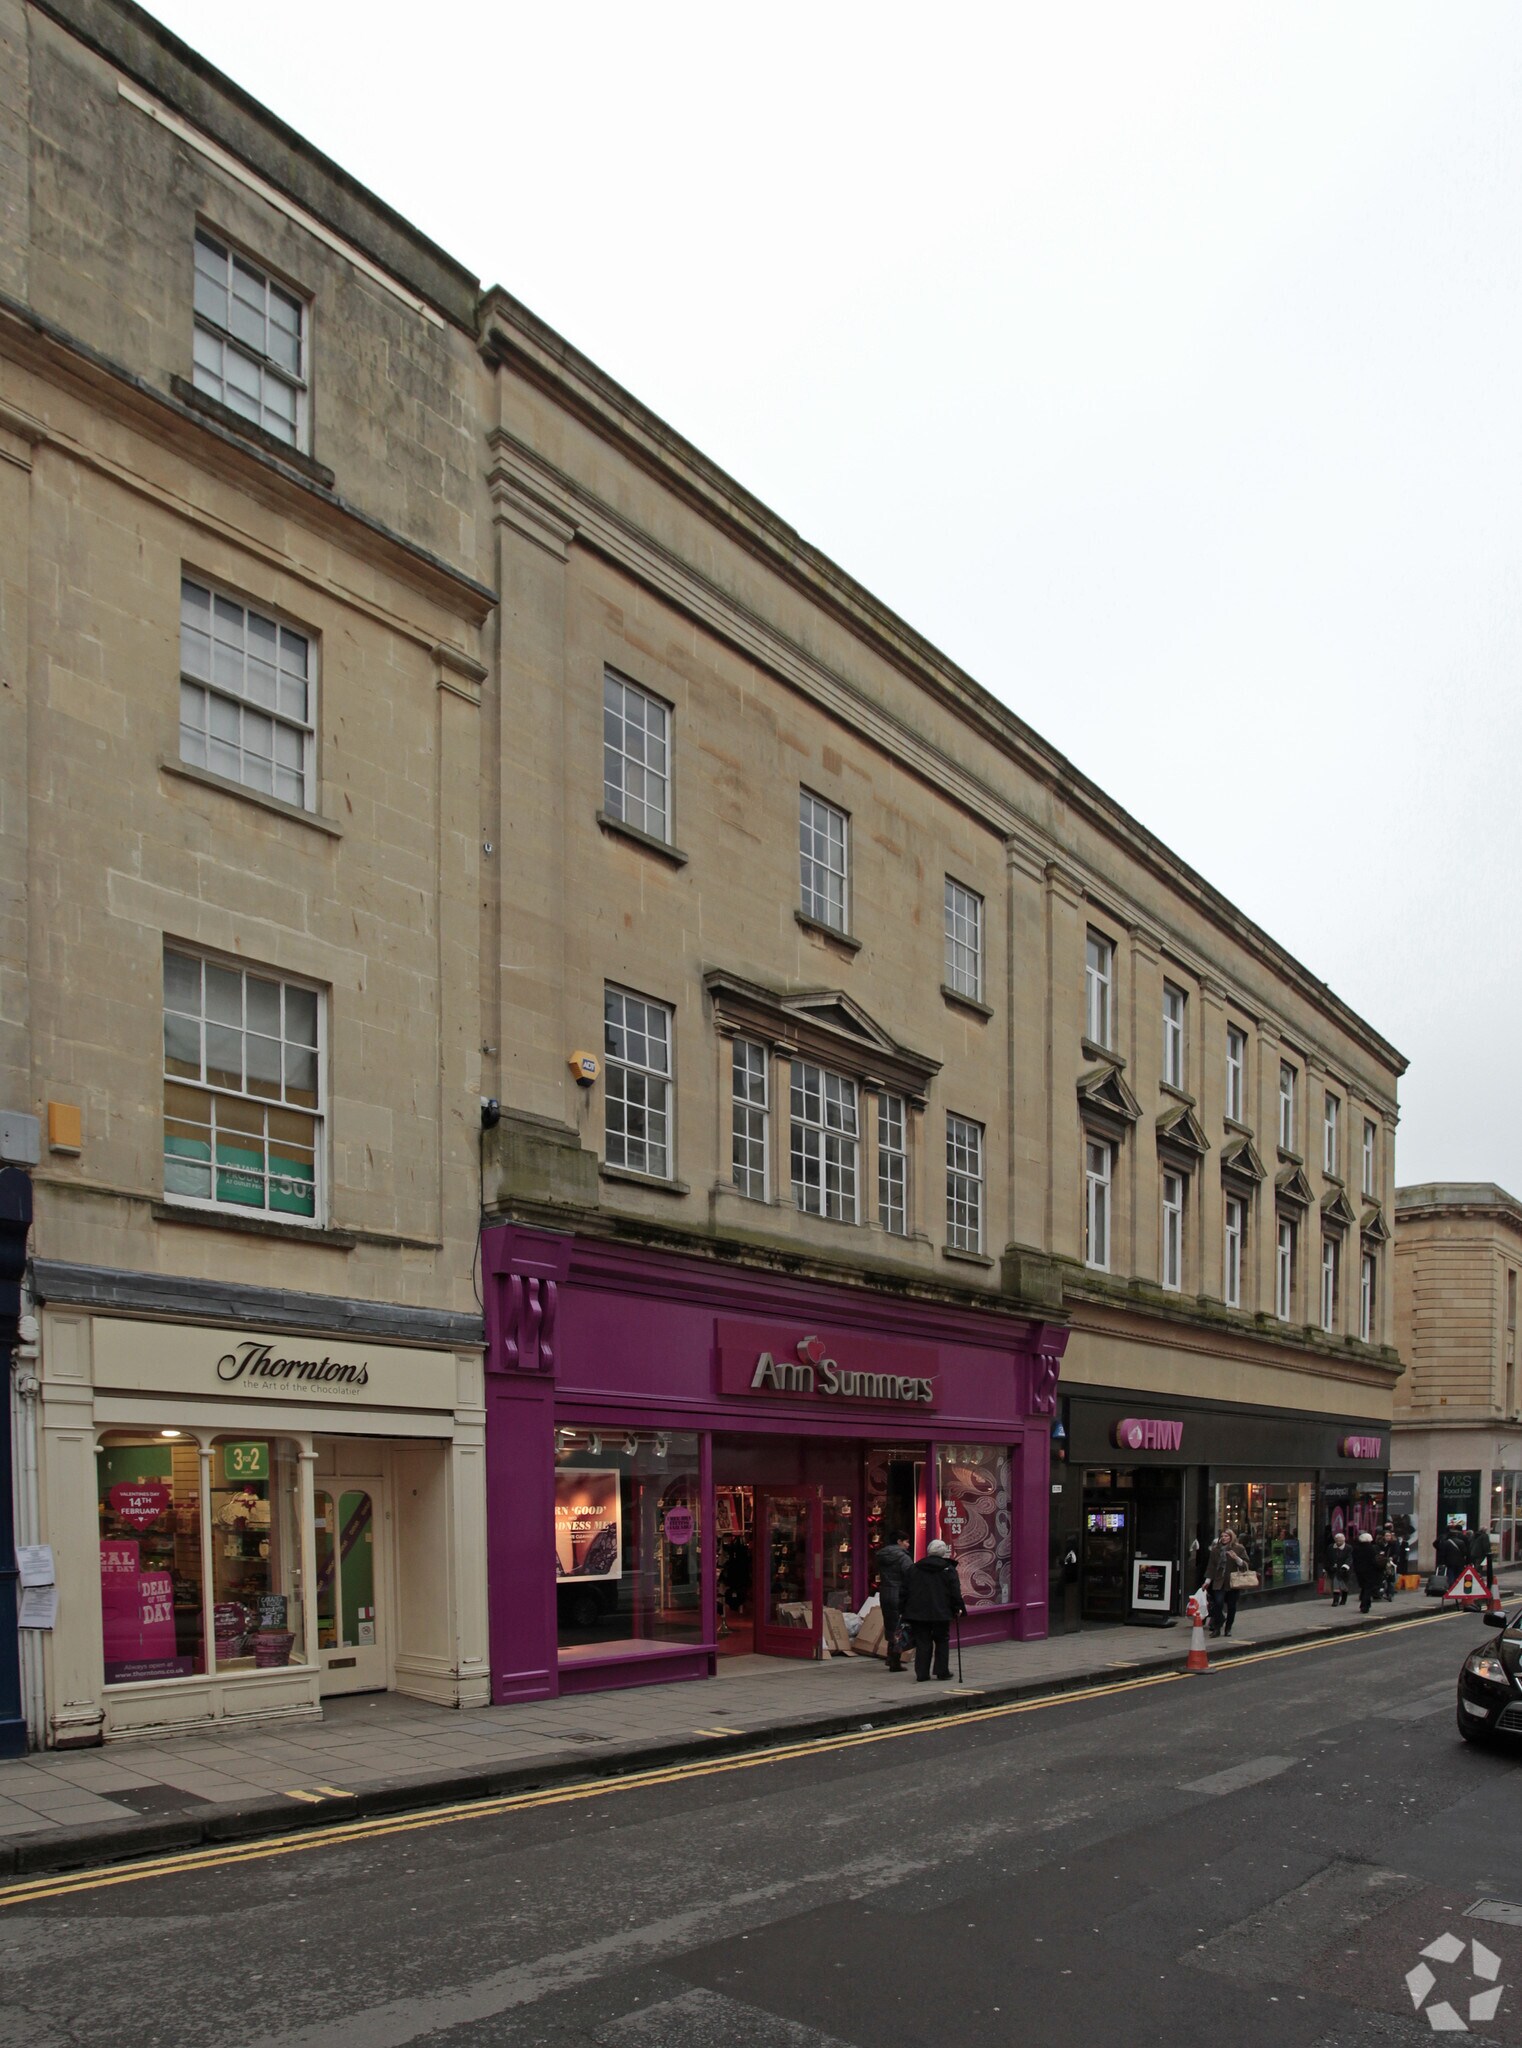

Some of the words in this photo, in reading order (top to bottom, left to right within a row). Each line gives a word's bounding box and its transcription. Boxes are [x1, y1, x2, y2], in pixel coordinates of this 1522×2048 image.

[217, 1341, 369, 1385] Thorntons
[751, 1352, 814, 1392] Ann
[817, 1359, 933, 1402] Summers
[243, 1380, 258, 1389] the
[262, 1381, 277, 1390] Art
[280, 1382, 290, 1391] of
[293, 1384, 308, 1392] the
[310, 1385, 360, 1395] Chocolatier
[1144, 1419, 1183, 1451] HMV
[1360, 1436, 1381, 1459] HMV
[233, 1448, 243, 1471] 3
[250, 1448, 260, 1470] 2
[1443, 1475, 1472, 1487] M&S
[129, 1497, 152, 1507] 14TH
[947, 1507, 957, 1517] £5
[555, 1521, 591, 1530] DNESS
[952, 1524, 961, 1534] £3
[100, 1552, 135, 1565] EAL
[142, 1580, 171, 1597] DEAL
[143, 1603, 172, 1624] DAY
[115, 1667, 184, 1678] www.thorntons.co.uk
[124, 1663, 147, 1671] Always
